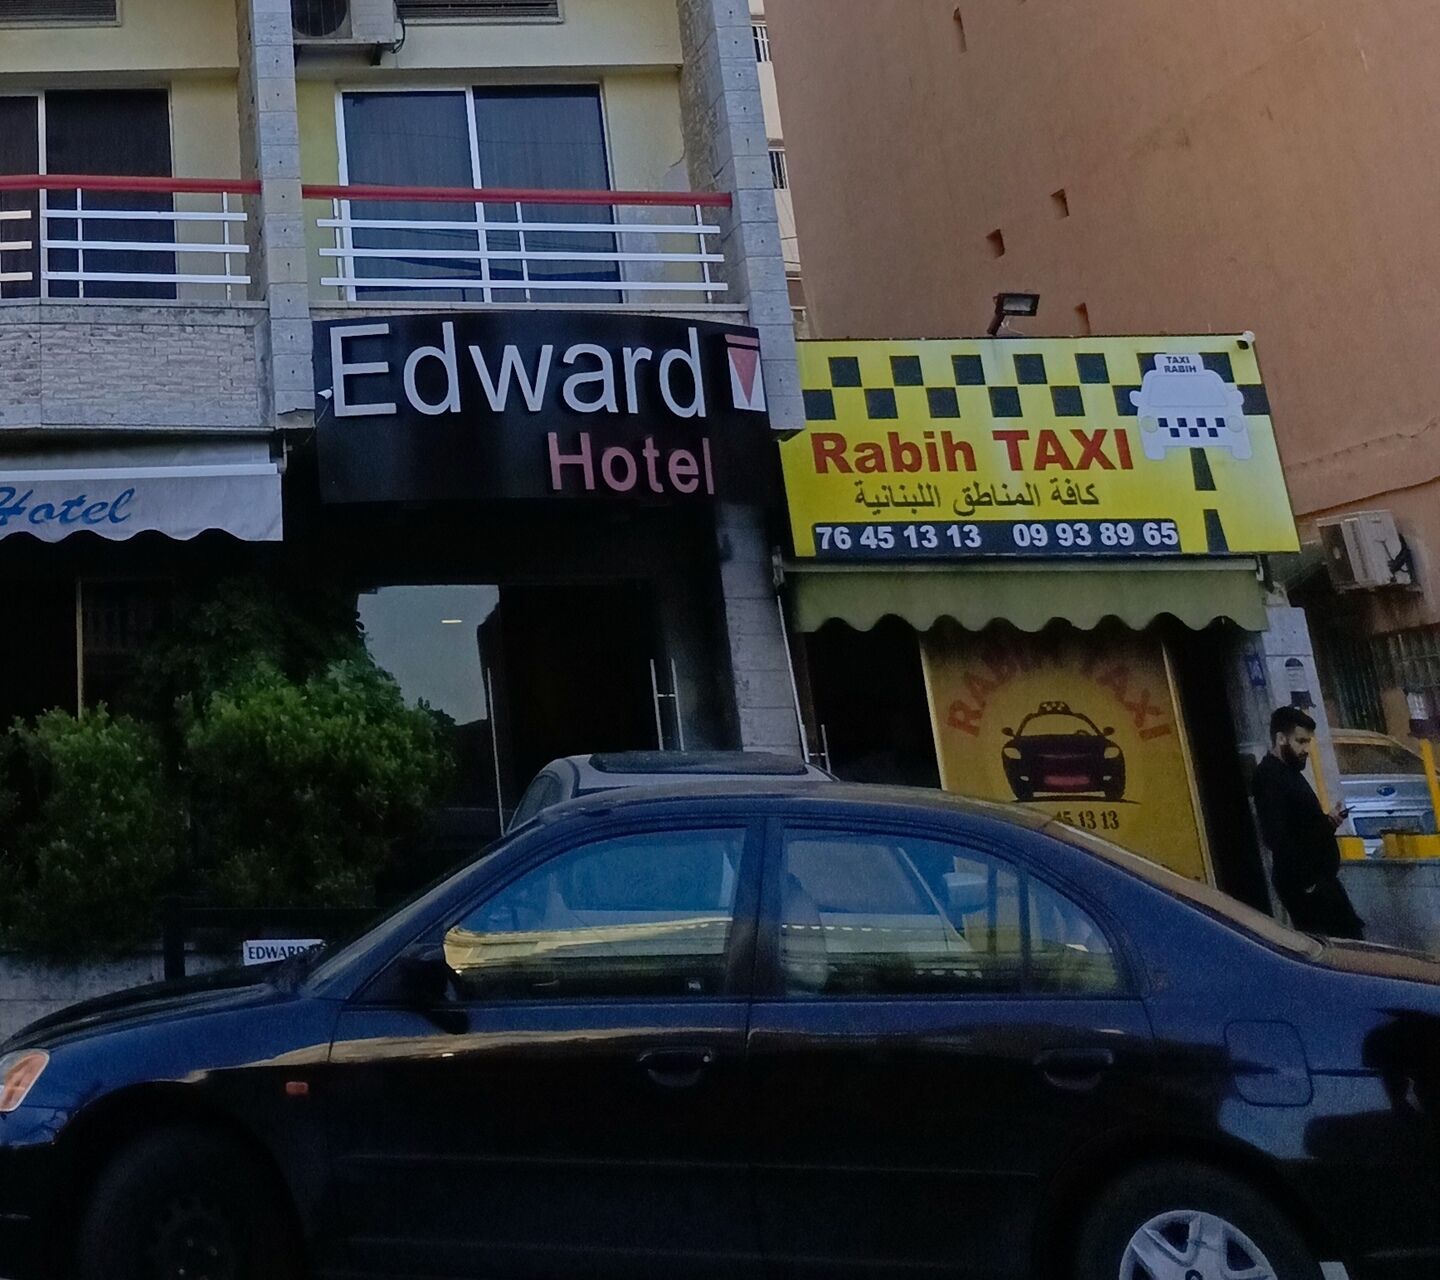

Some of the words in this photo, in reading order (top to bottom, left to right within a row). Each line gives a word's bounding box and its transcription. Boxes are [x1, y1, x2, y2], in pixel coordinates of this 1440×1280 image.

[329, 321, 707, 419] Edward
[1164, 365, 1197, 374] RABIH
[1166, 355, 1190, 364] TAXI
[547, 431, 715, 495] Hotel
[810, 429, 977, 474] Rabih
[993, 429, 1133, 472] TAXI
[854, 479, 941, 516] اللبنانية
[952, 480, 1040, 517] المناطق
[1051, 476, 1100, 507] كافة
[815, 526, 851, 550] 76
[859, 526, 894, 549] 45
[904, 525, 938, 549] 13
[947, 525, 982, 548] 13
[1013, 523, 1047, 547] 09
[1056, 523, 1091, 547] 93
[1100, 522, 1135, 546] 89
[1143, 521, 1178, 546] 65
[1078, 810, 1096, 829] 13
[1101, 810, 1119, 829] 13
